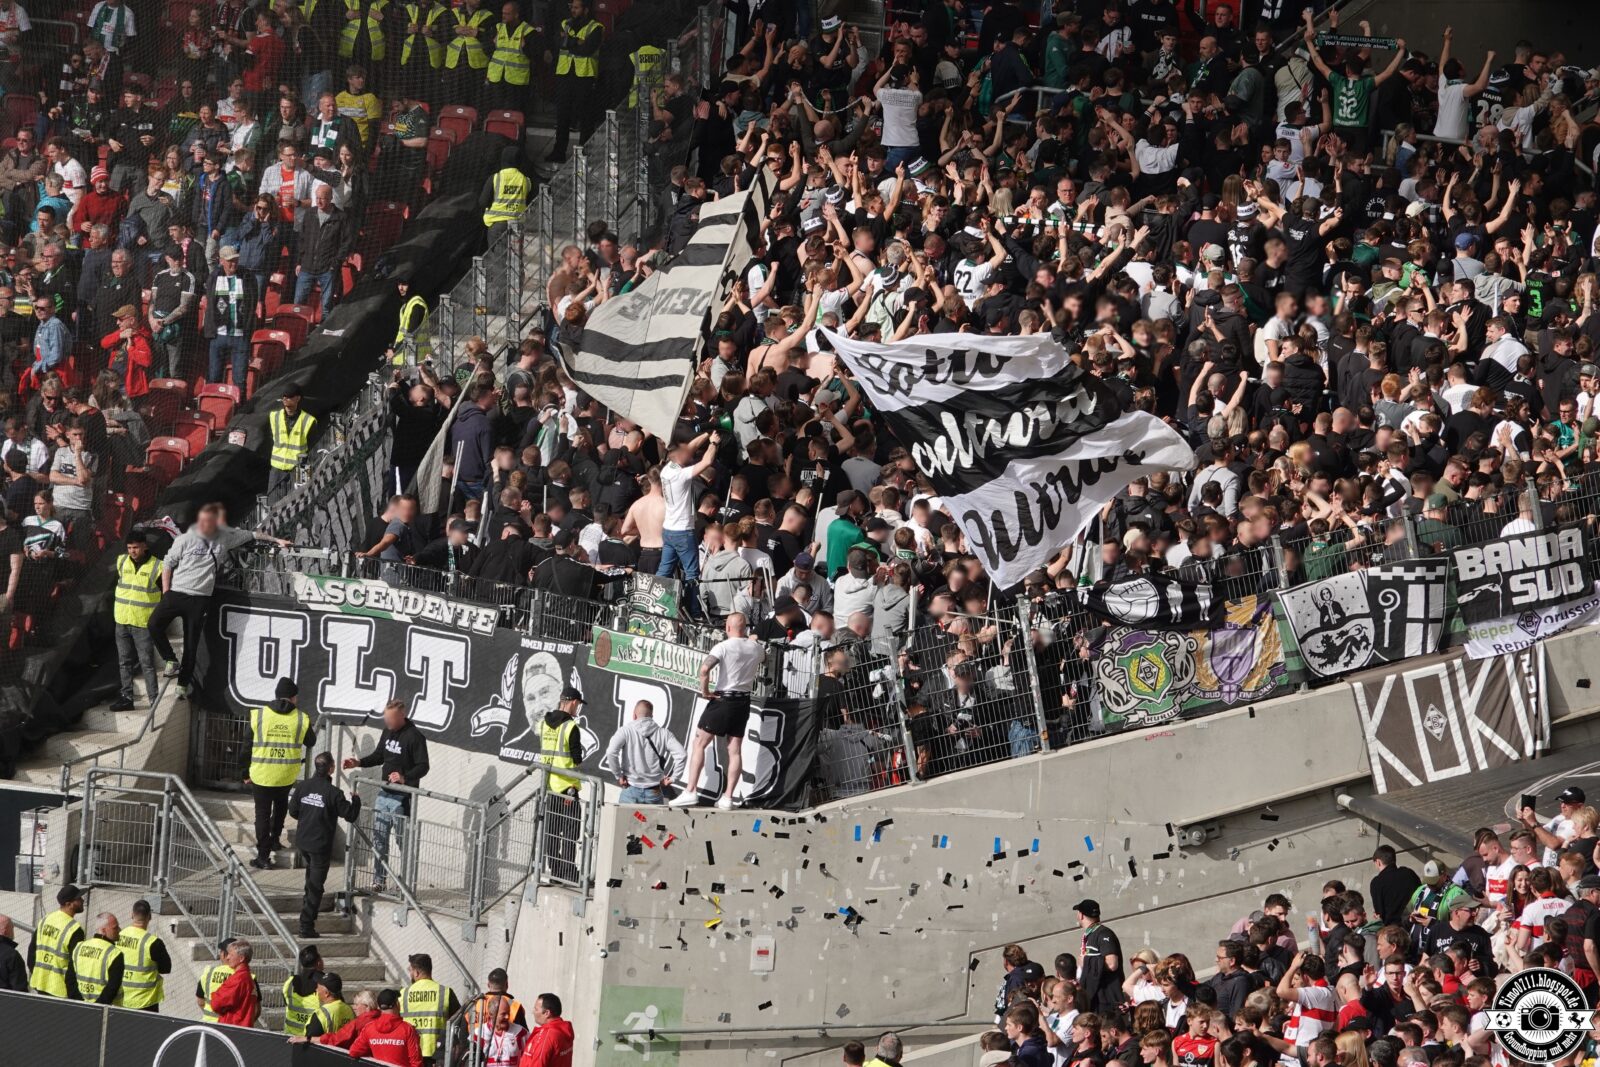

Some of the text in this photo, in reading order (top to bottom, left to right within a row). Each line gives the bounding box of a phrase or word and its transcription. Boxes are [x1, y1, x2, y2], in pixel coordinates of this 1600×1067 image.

[1338, 95, 1358, 119] 32
[955, 271, 973, 293] 22
[1527, 289, 1543, 318] 3
[1453, 528, 1584, 582] BANDA
[1508, 562, 1585, 606] SUD
[299, 578, 499, 637] ASCENDENTE
[520, 637, 574, 655] IMMER BEI UNS
[270, 748, 286, 758] 0762
[408, 989, 438, 1003] SECURITY
[412, 1017, 433, 1028] 3101
